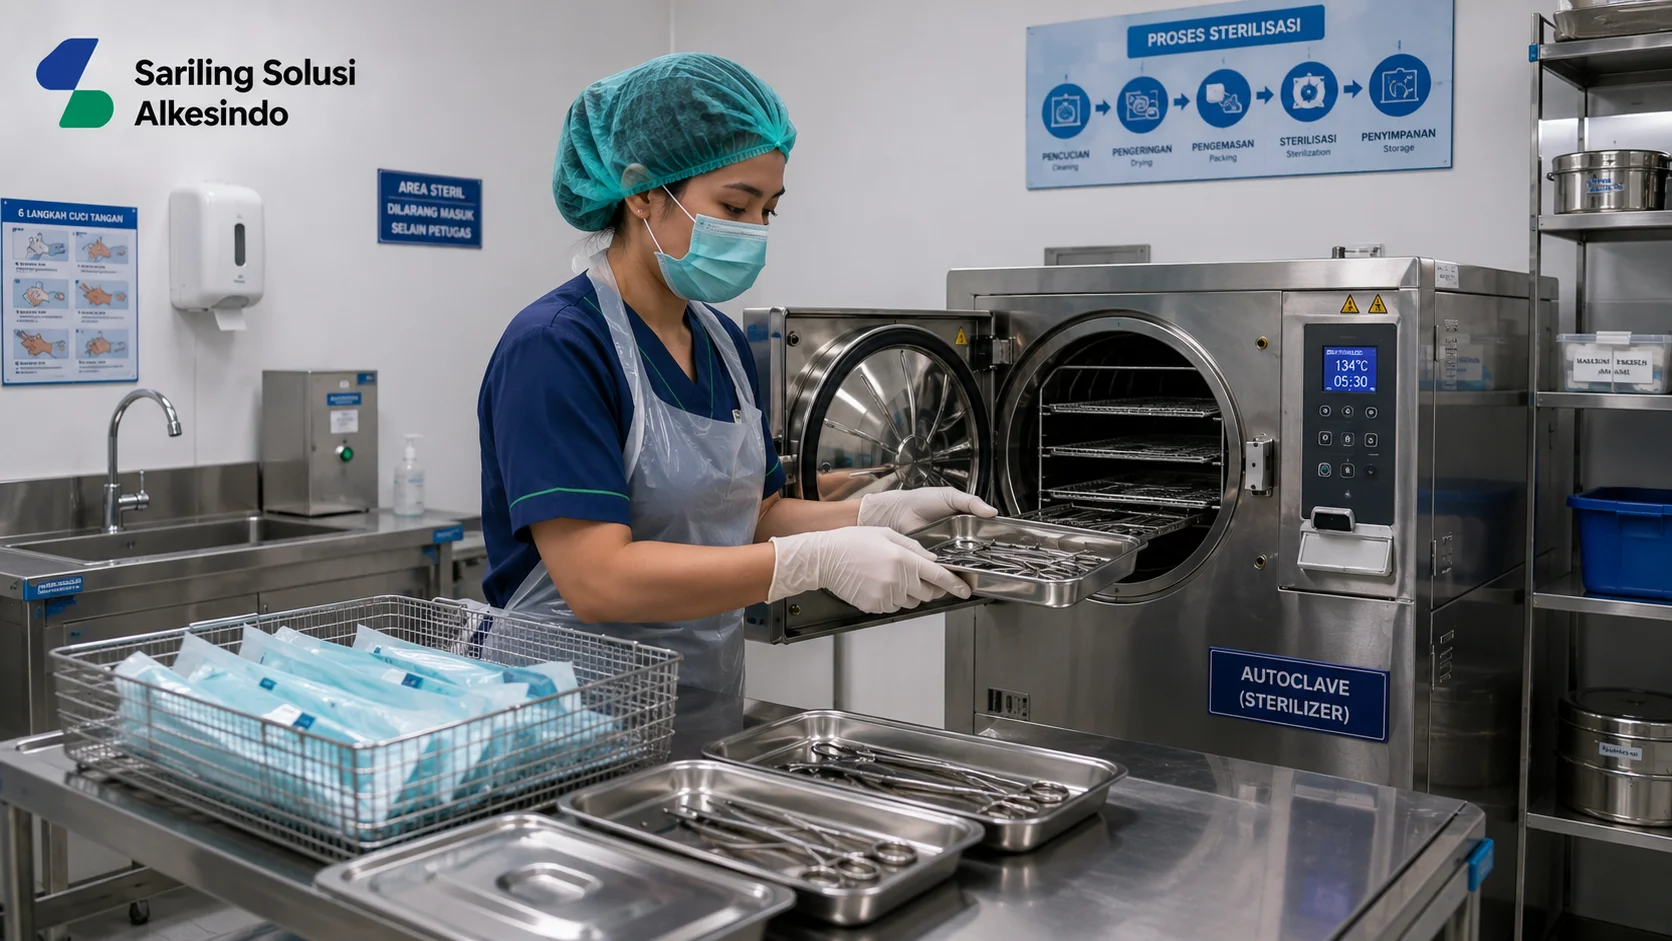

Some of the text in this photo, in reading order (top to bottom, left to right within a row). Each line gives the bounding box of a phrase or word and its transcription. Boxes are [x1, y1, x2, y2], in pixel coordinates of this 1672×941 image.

[1147, 17, 1301, 48] PROSES STERILISASI
[1279, 133, 1337, 147] STERILISASI
[1361, 128, 1437, 142] PENYIMPANAN
[1112, 144, 1173, 157] PENGERINGAN
[1191, 139, 1255, 152] PENGEMASAN
[1383, 143, 1415, 154] Storage
[1042, 150, 1090, 161] PENCUCIAN
[1209, 153, 1238, 164] Packing
[1286, 147, 1331, 158] Sterilization
[1051, 162, 1079, 172] Cleaning
[1130, 158, 1153, 168] Drying
[398, 181, 466, 199] AREA STERIL
[17, 208, 124, 223] 6 LANGKAH CUCI TANGAN
[387, 202, 475, 221] DILARANG MASUK
[391, 222, 472, 239] SELAIN PETUGAS
[1335, 359, 1369, 372] 134°C
[1333, 375, 1368, 388] 05:30
[1240, 666, 1350, 697] AUTOCLAVE
[1239, 690, 1350, 725] (STERILIZER)
